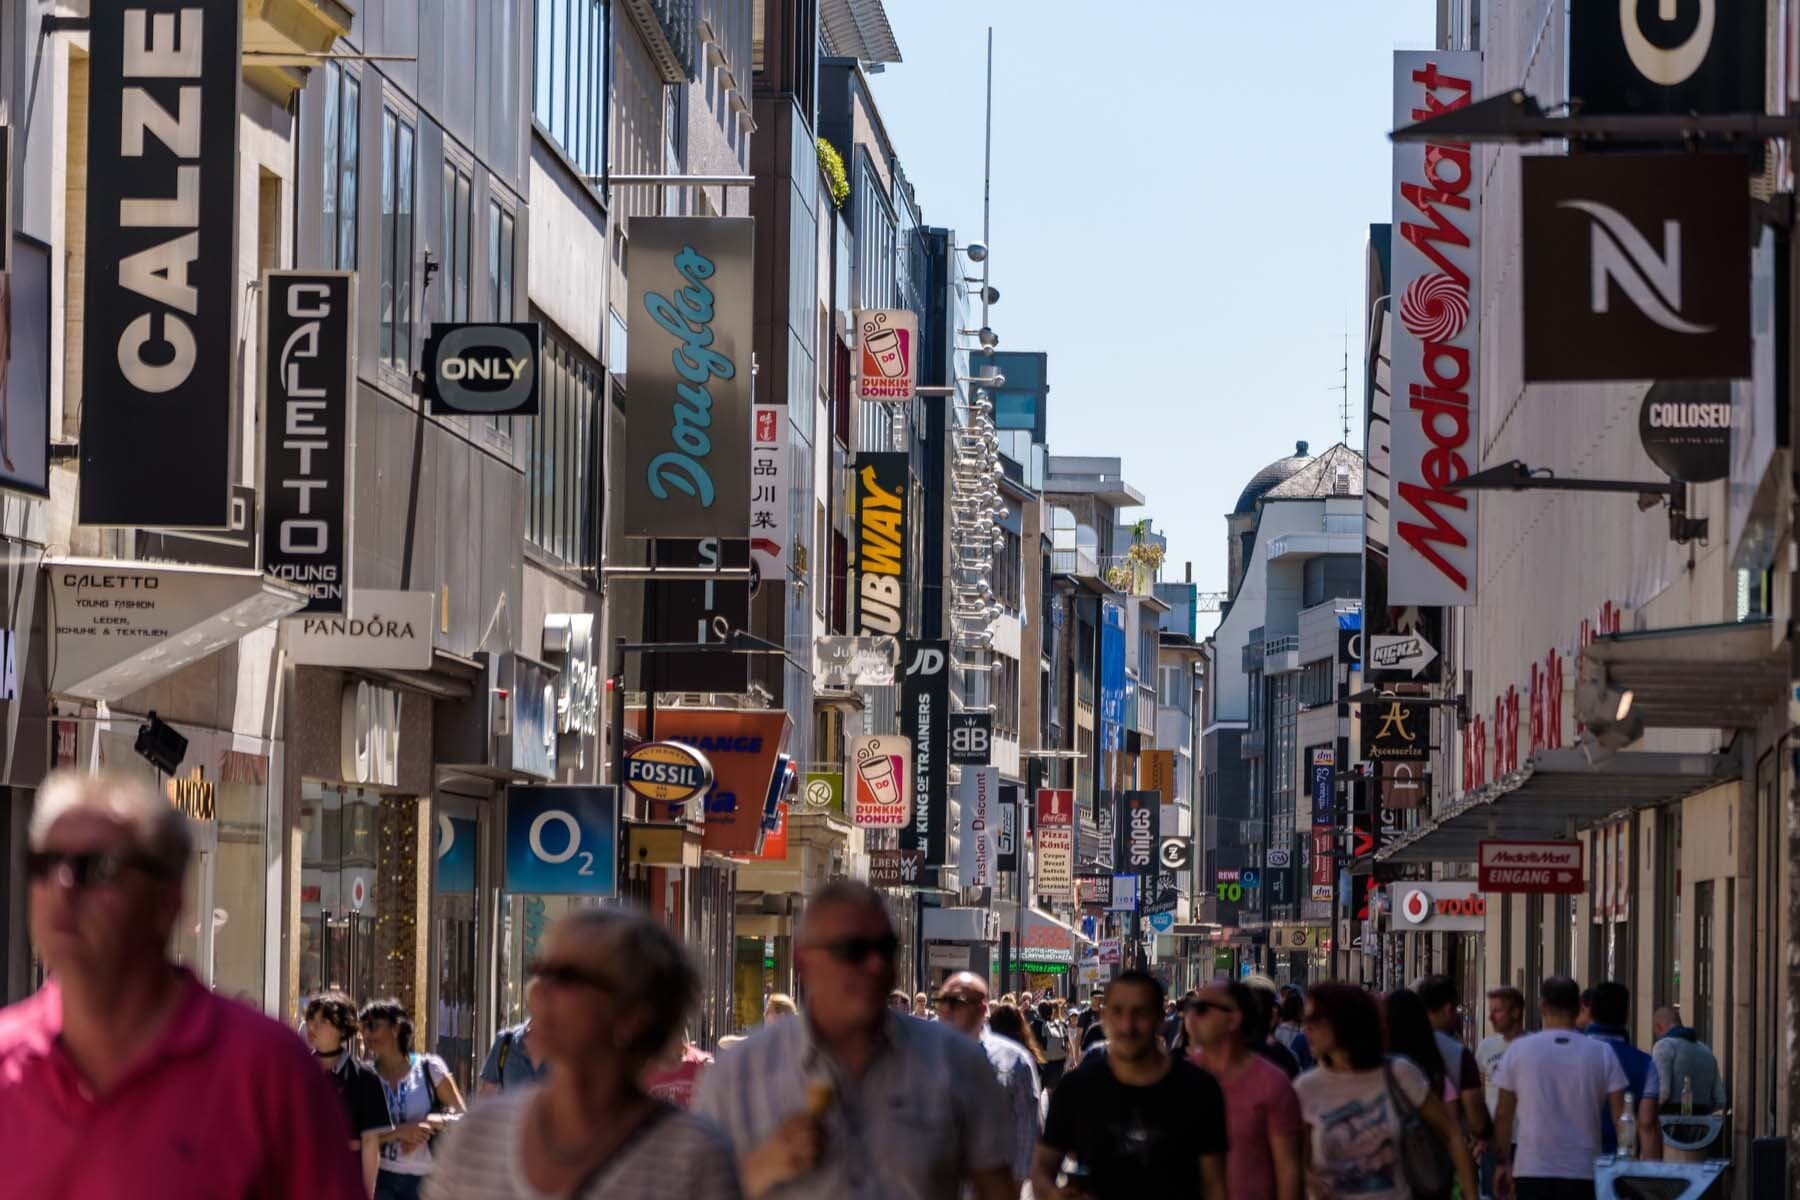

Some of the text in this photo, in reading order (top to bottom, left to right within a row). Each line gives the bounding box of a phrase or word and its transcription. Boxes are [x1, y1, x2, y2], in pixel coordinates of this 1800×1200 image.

[117, 8, 203, 393] CALZE
[441, 357, 529, 380] ONLY
[644, 245, 736, 508] Douglas
[862, 379, 911, 387] DUNKIN'
[862, 388, 909, 397] DONUTS
[280, 283, 331, 554] CALETTO
[860, 465, 902, 637] UBWAY
[269, 564, 337, 581] YOUNG
[64, 574, 159, 597] CALETTO
[76, 600, 109, 609] YOUNG
[906, 649, 944, 675] JD
[629, 761, 697, 786] FOSSIL
[916, 693, 931, 832] KING OF TRAINERS
[856, 805, 905, 814] DUNKIN'
[856, 815, 902, 824] DONUTS
[973, 773, 986, 887] Fashion Discount
[1131, 809, 1153, 865] snipes
[529, 810, 594, 875] O2
[1040, 840, 1070, 850] König
[1218, 872, 1240, 880] REWE
[1488, 869, 1551, 884] EINGANG
